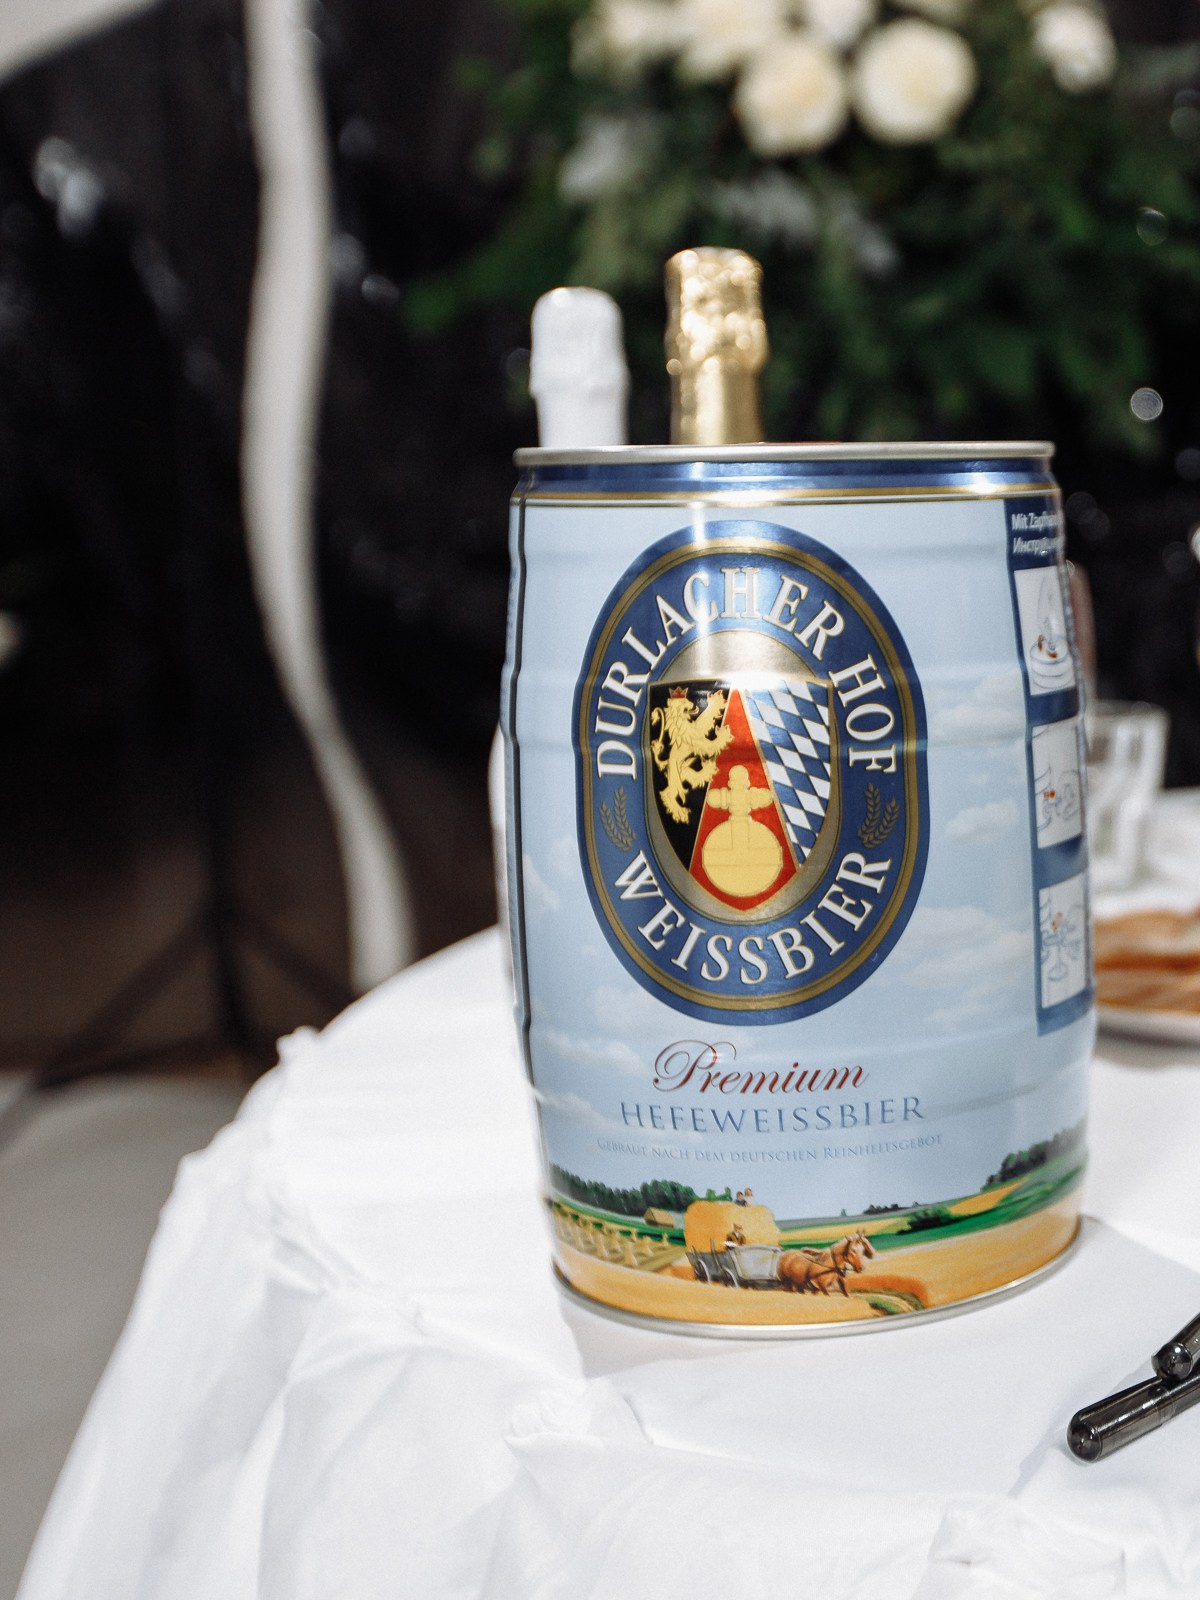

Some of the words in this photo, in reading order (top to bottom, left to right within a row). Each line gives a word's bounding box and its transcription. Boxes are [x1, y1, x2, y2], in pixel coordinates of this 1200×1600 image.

[594, 566, 845, 780] DURLACHER
[829, 652, 896, 774] HOF
[613, 849, 891, 985] WEISSBIER
[651, 1038, 870, 1096] Premium
[619, 1095, 926, 1134] HEFEWEISSBIER
[651, 1147, 690, 1161] NACH
[695, 1150, 726, 1163] DEM
[730, 1149, 818, 1163] DEUTSCHEN
